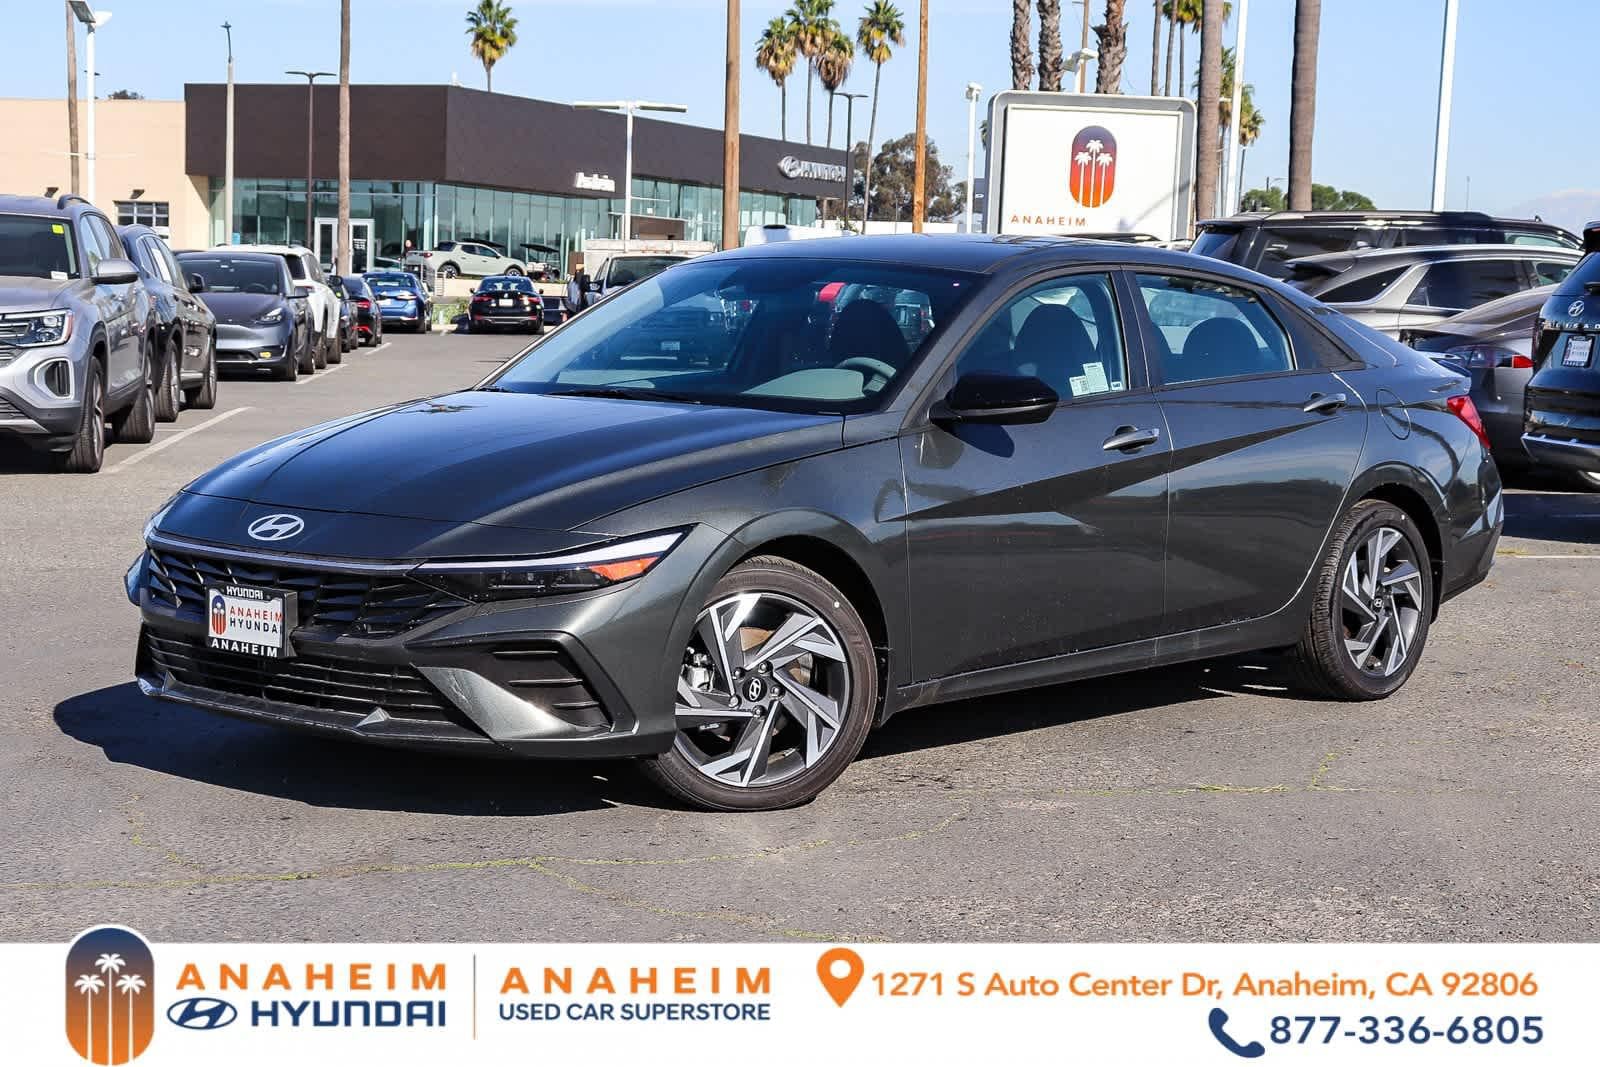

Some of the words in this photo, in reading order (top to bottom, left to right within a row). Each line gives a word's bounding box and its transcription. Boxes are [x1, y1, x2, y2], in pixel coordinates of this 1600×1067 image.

[1010, 214, 1087, 227] ANAHEIM
[226, 586, 263, 599] HYUNDAI
[230, 606, 283, 622] ANAHEIM
[211, 638, 278, 657] ANAHEIM
